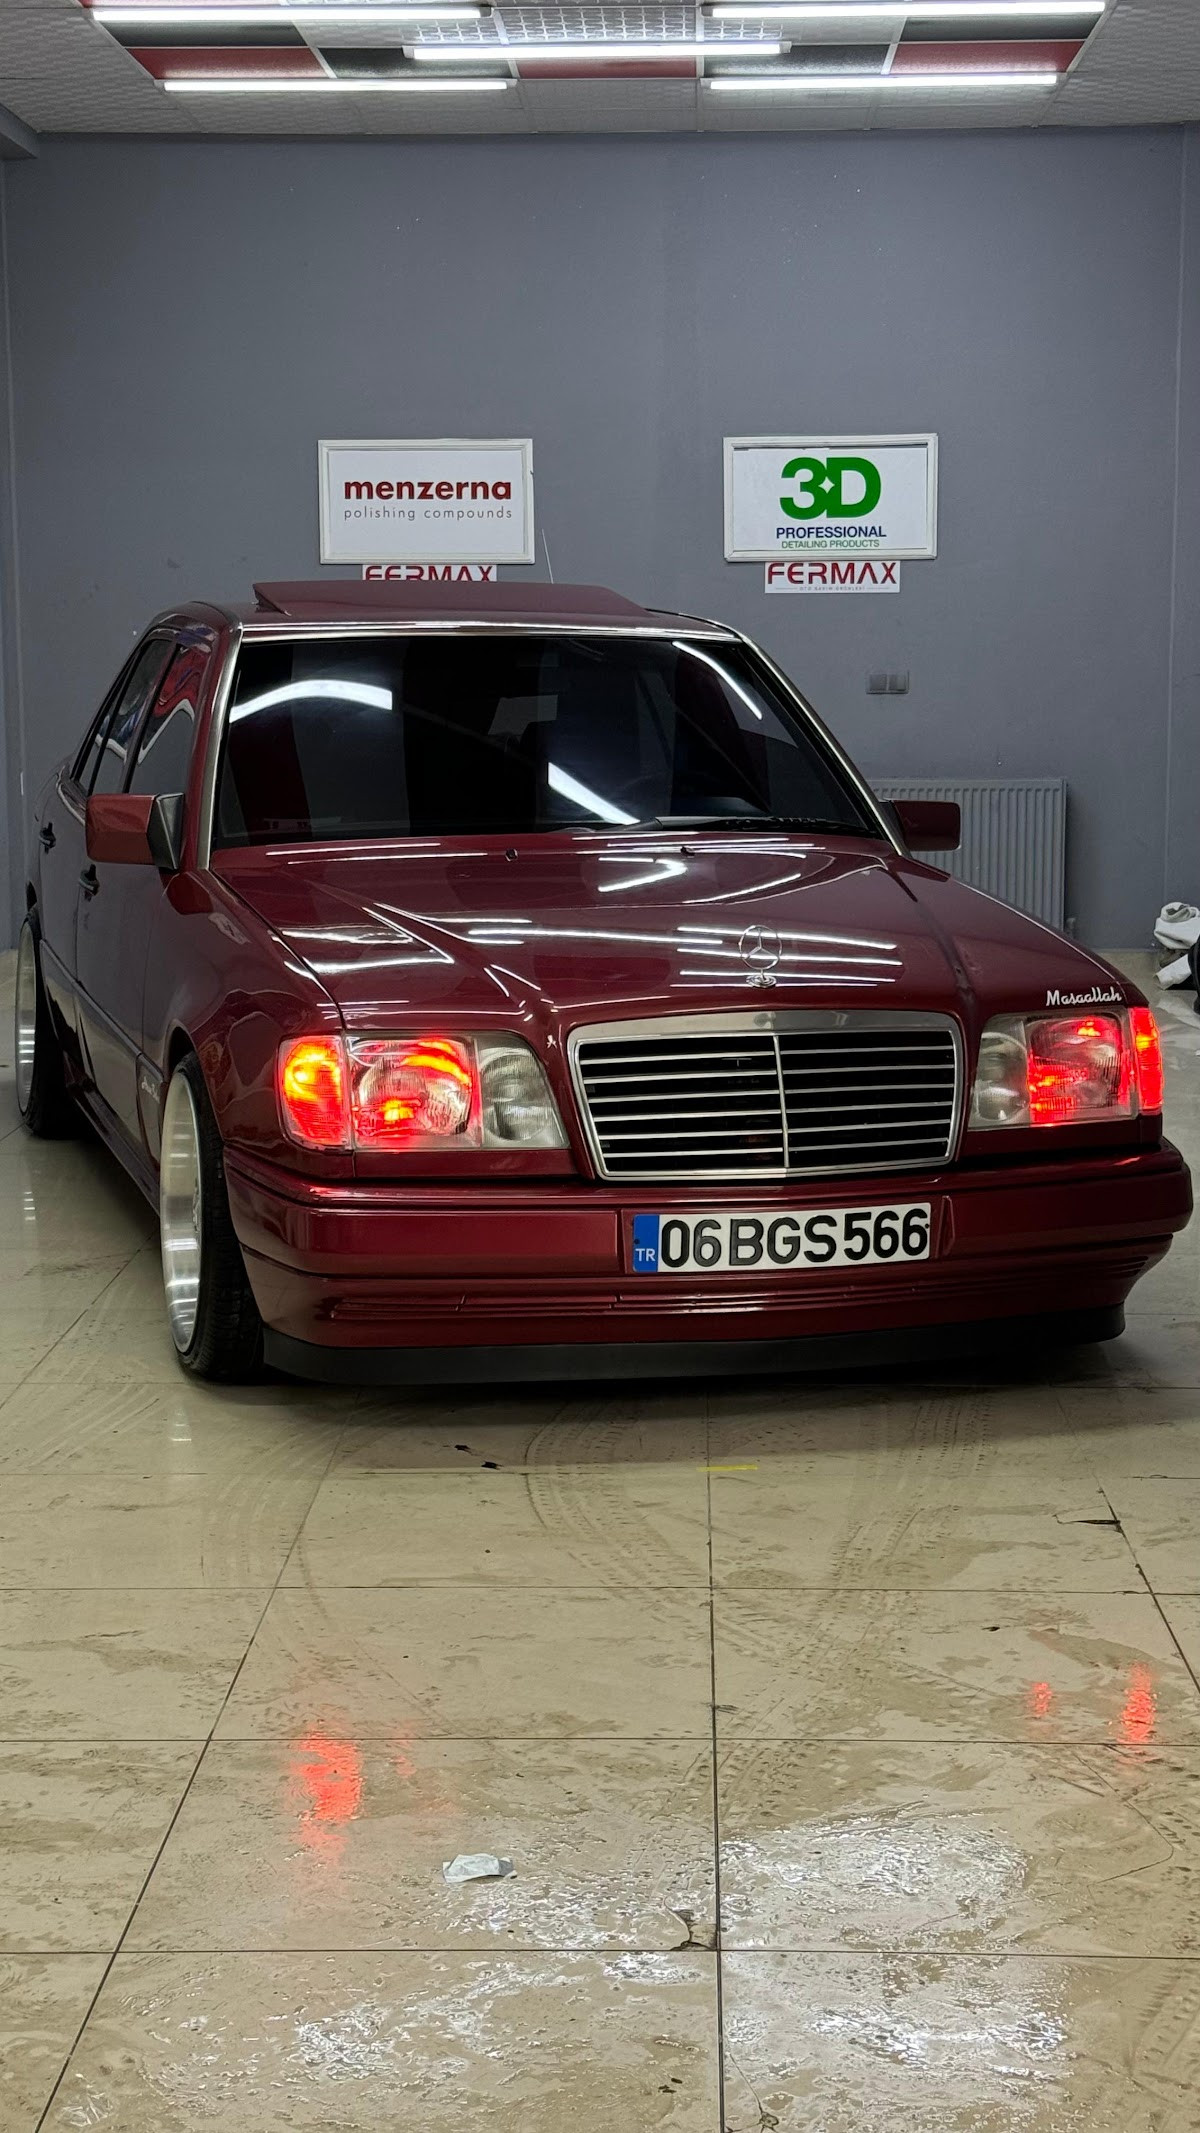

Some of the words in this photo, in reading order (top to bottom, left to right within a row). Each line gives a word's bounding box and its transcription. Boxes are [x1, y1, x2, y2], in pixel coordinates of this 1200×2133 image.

[344, 480, 512, 500] menzerna
[779, 456, 882, 520] 3D
[344, 505, 416, 521] polishing
[423, 505, 513, 521] compounds
[776, 526, 887, 539] PROFESSIONAL
[781, 541, 828, 549] DETAILING
[829, 539, 880, 548] PRODUCTS
[767, 561, 897, 585] FERMAX
[635, 1248, 656, 1262] TR
